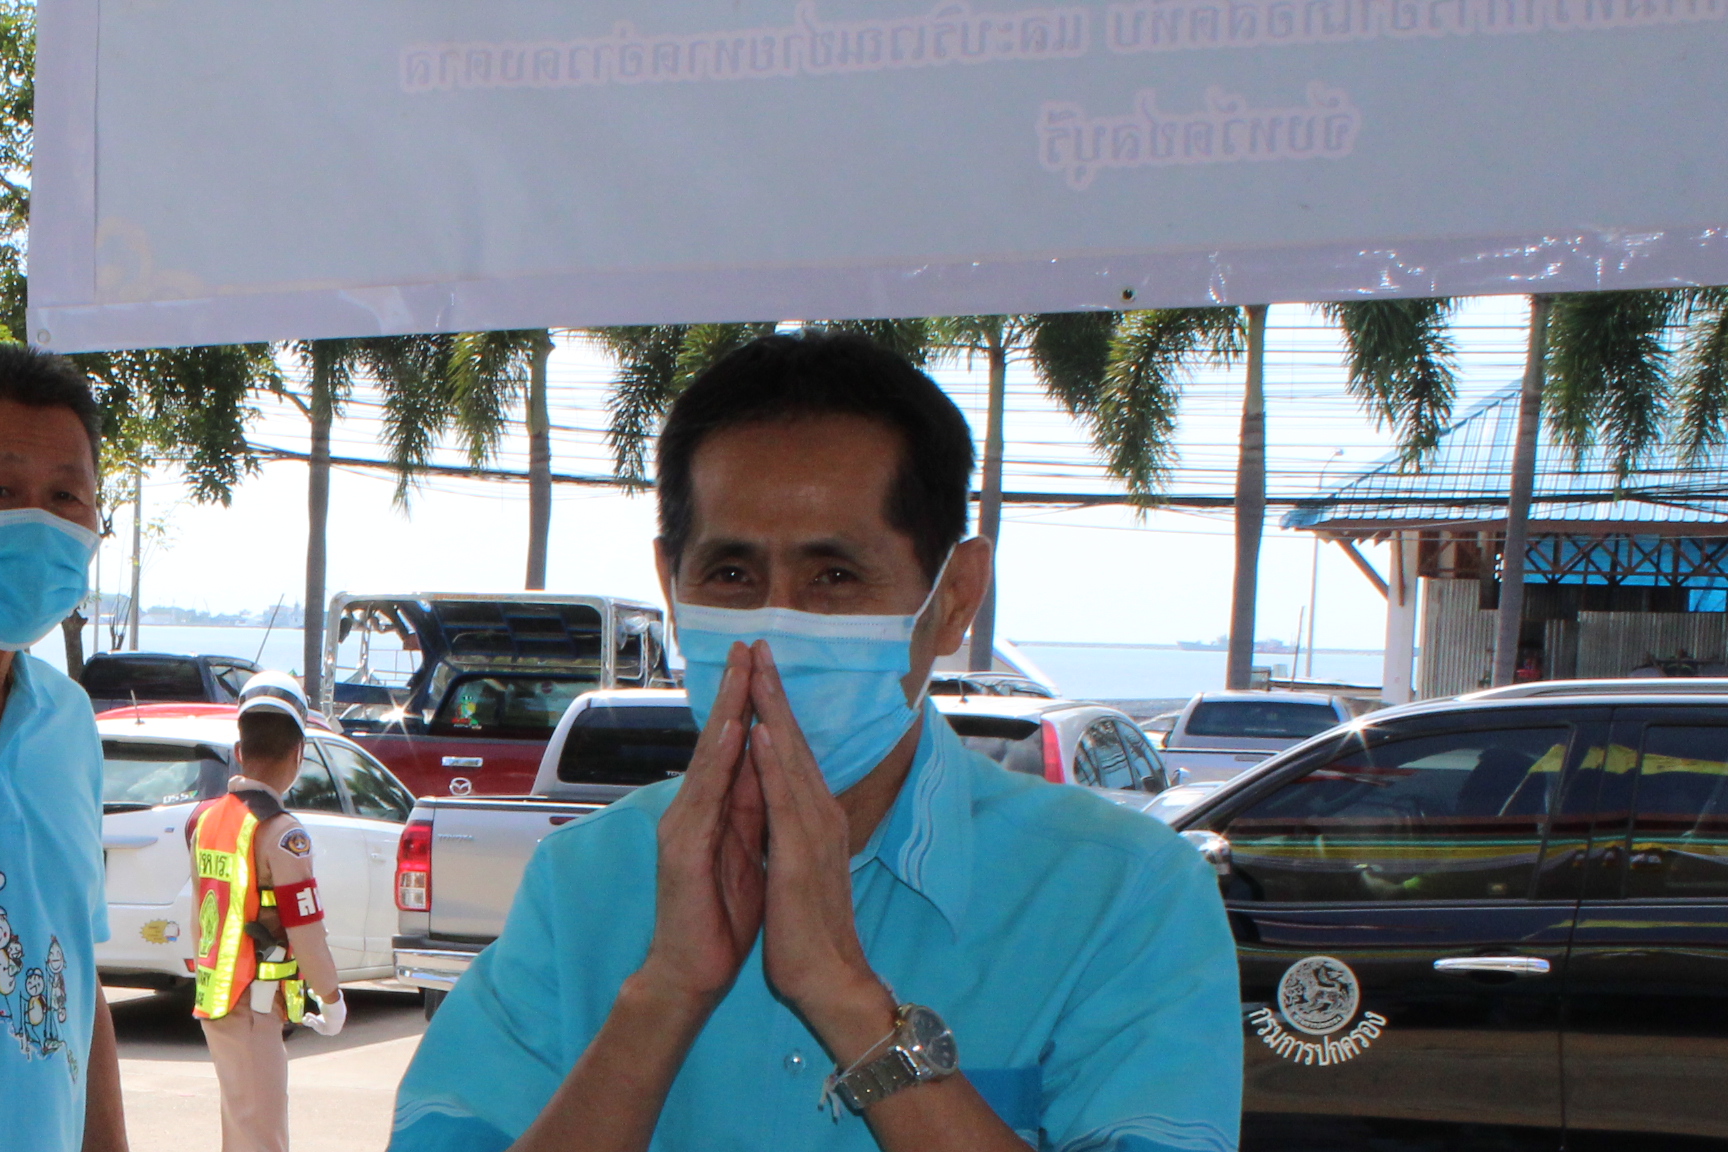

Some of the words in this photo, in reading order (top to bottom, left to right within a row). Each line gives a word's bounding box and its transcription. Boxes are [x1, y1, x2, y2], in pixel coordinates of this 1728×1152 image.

[1247, 1007, 1388, 1066] กรมการปกครอง
